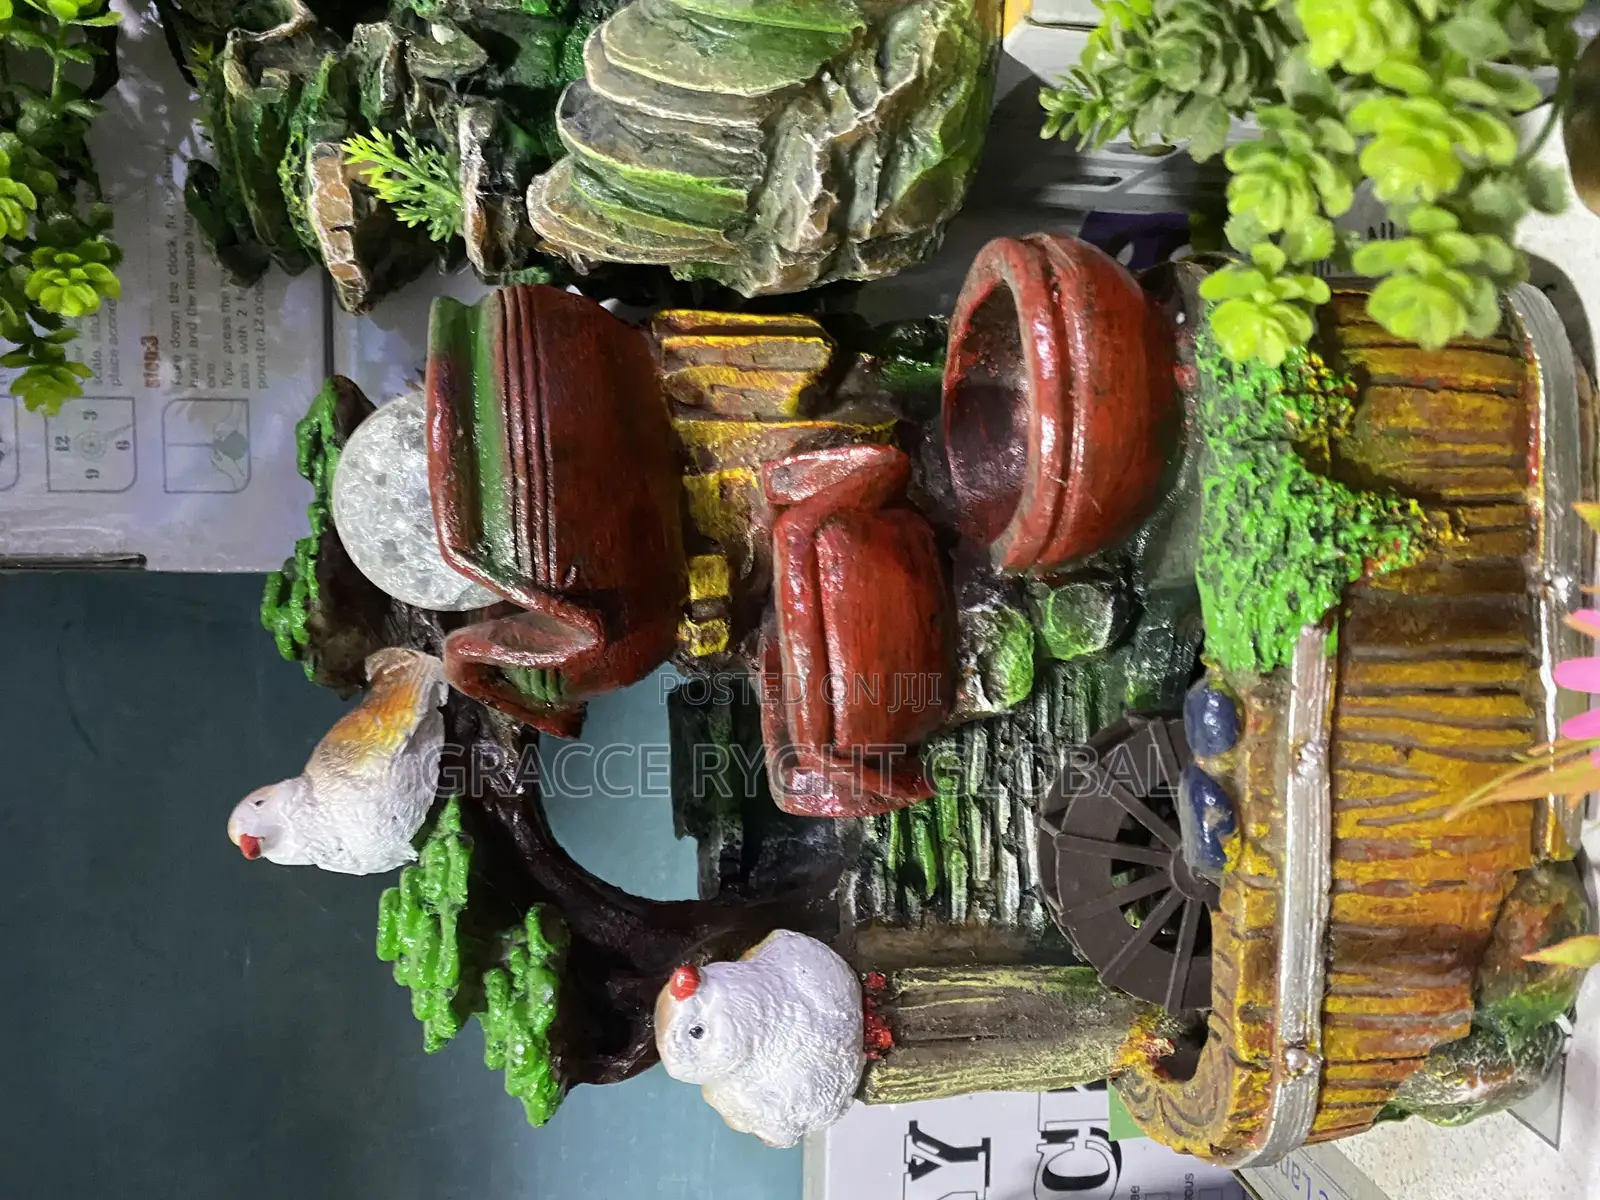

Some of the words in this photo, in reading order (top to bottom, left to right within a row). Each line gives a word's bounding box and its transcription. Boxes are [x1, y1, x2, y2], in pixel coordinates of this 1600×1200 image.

[181, 210, 195, 237] han
[182, 241, 197, 290] minute
[166, 281, 180, 304] the
[182, 295, 197, 317] the
[234, 309, 248, 317] 2
[168, 310, 182, 349] down
[183, 321, 199, 349] and
[184, 353, 199, 388] hand
[82, 410, 99, 421] 3
[54, 435, 71, 452] 12
[115, 440, 131, 451] 6
[84, 468, 100, 480] 9
[902, 1120, 990, 1200] Y
